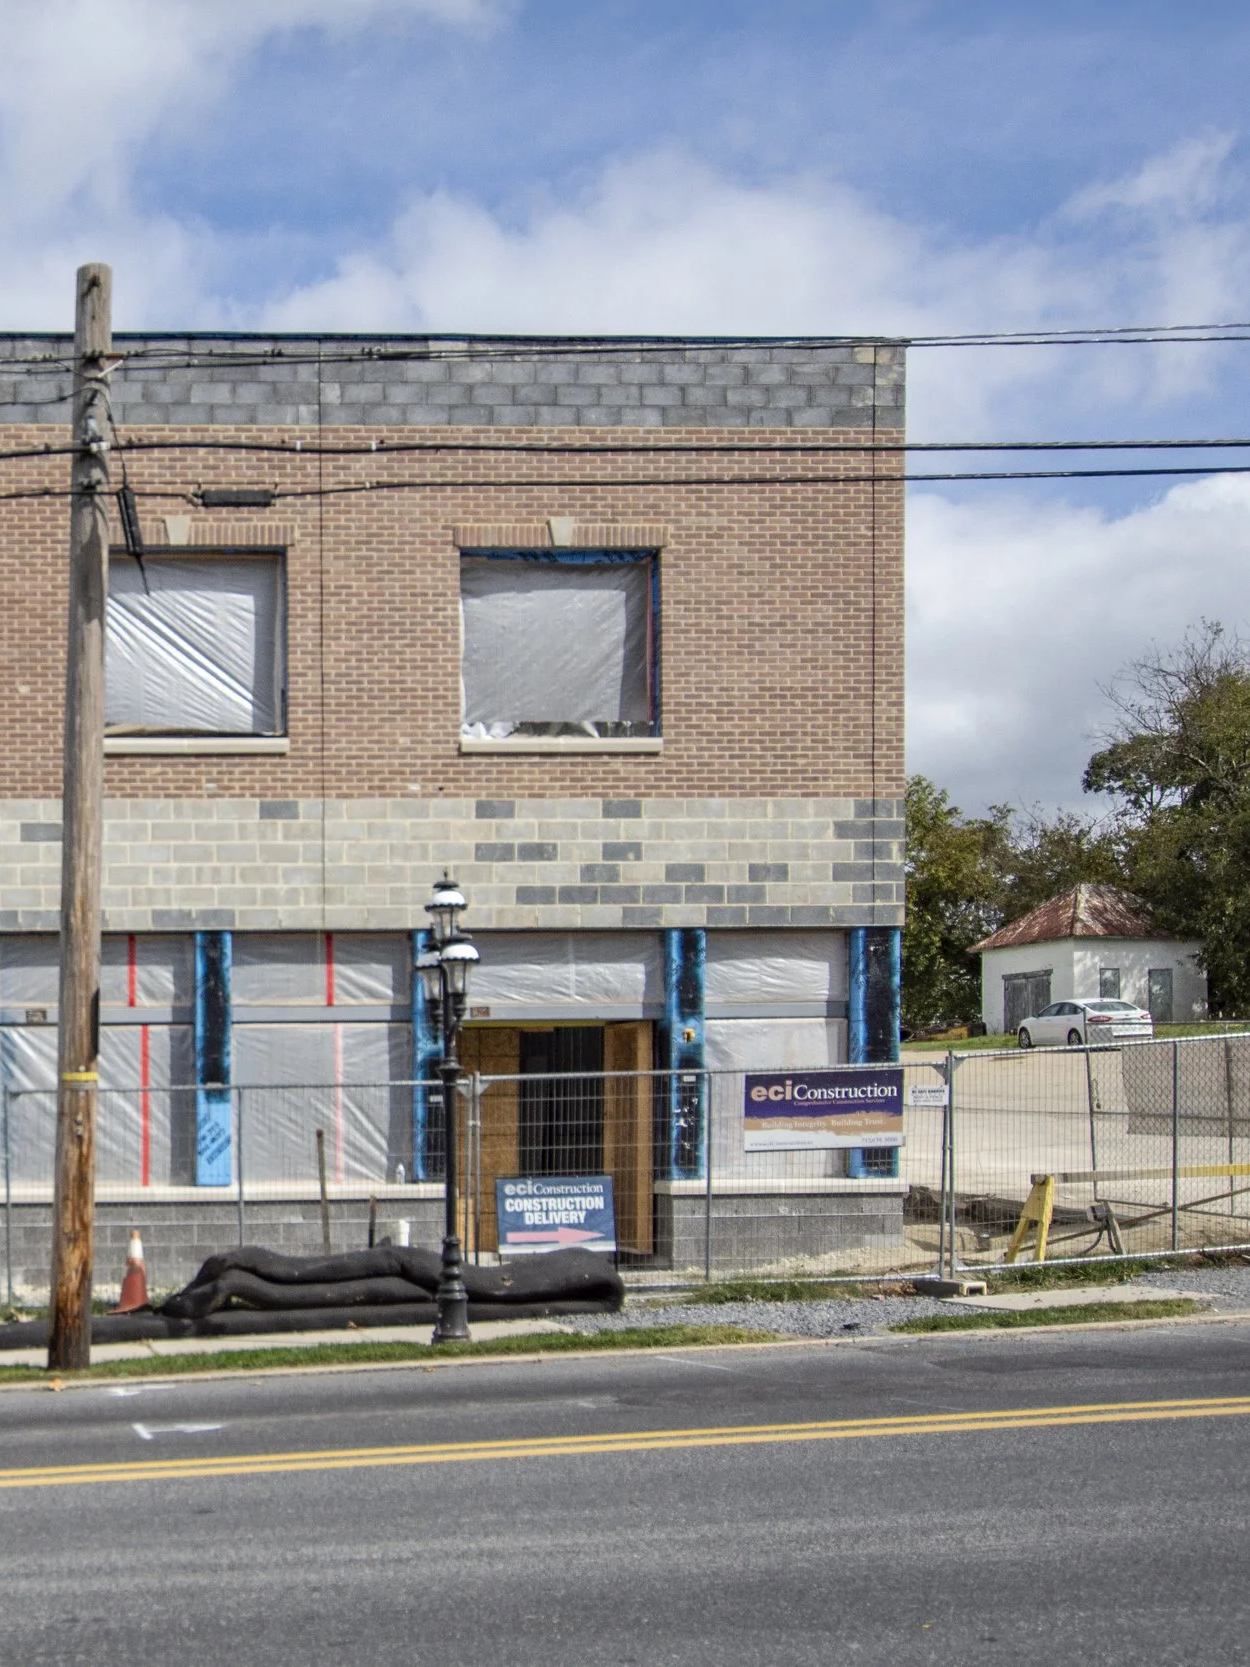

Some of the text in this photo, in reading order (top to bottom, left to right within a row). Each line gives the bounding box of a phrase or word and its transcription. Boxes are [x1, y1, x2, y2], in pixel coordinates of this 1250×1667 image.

[762, 1120, 793, 1129] Building
[831, 1119, 863, 1127] Building
[504, 1196, 605, 1212] CONSTRUCTION
[524, 1211, 587, 1225] DELIVERY
